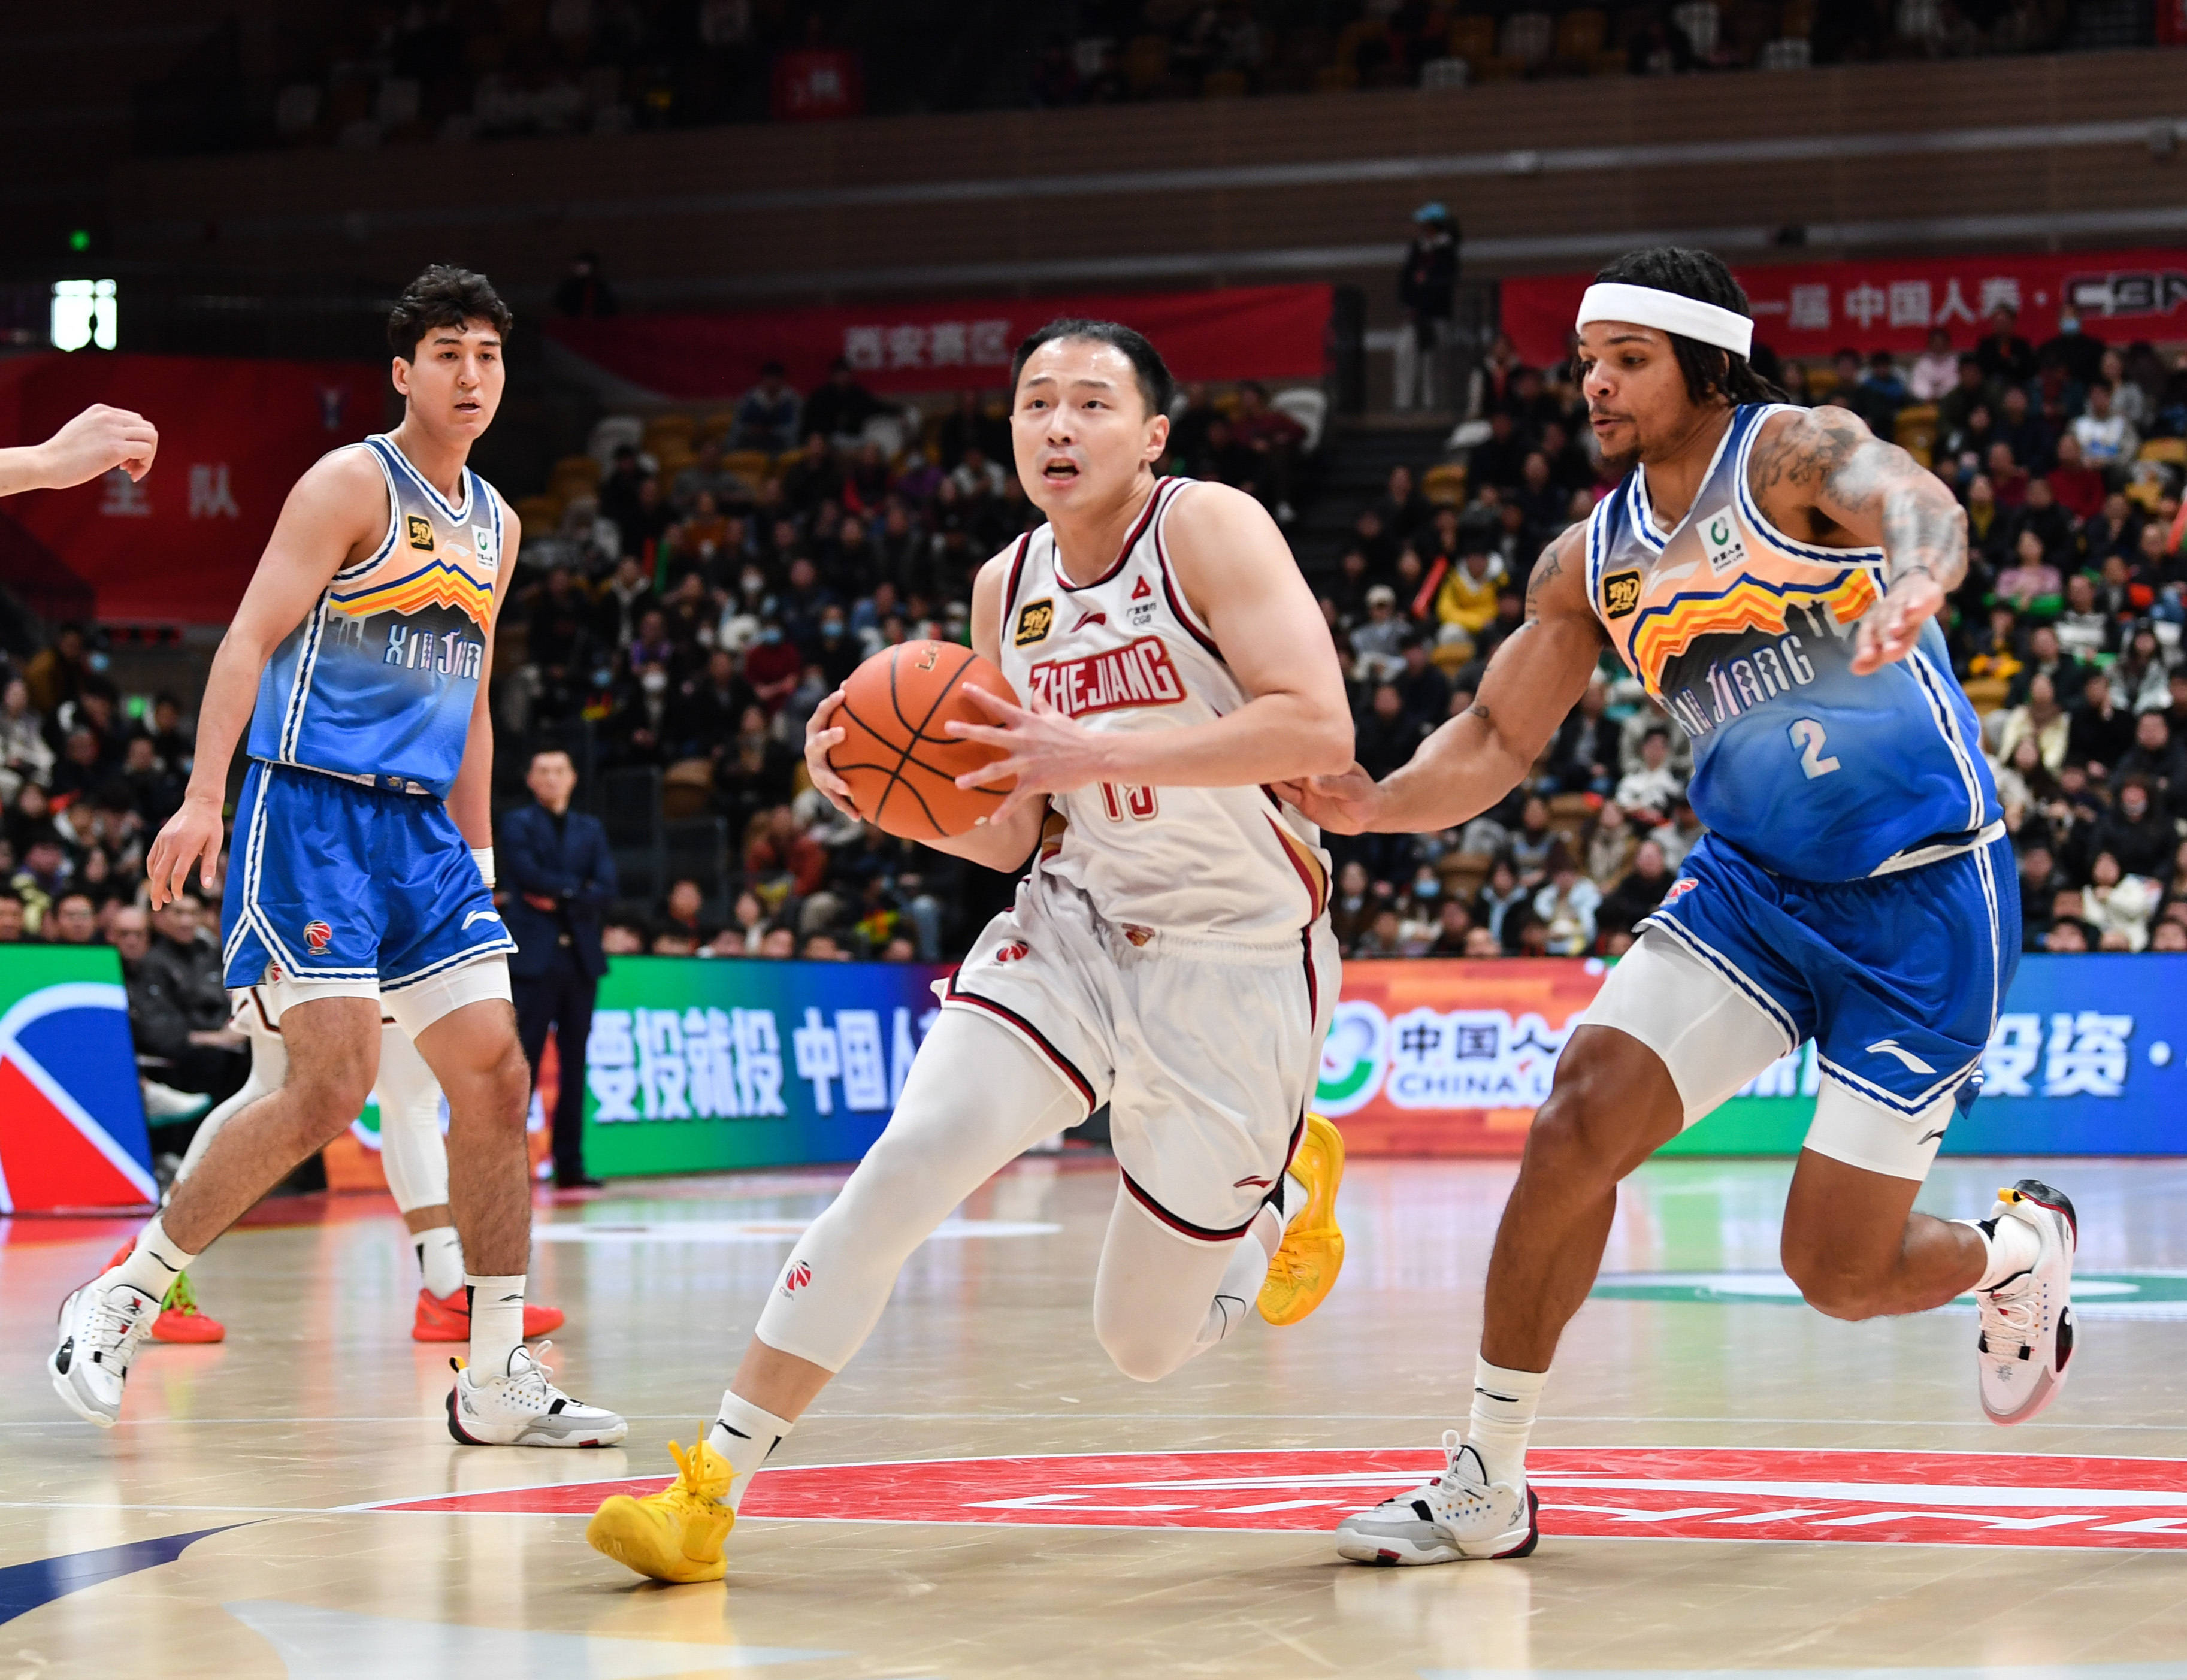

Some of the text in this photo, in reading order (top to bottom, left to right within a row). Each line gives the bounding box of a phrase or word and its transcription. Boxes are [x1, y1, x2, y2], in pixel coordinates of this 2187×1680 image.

[1030, 640, 1182, 716] ZHEJIANG
[1787, 717, 1841, 780] 2
[1400, 1022, 1557, 1062] 中国人
[1397, 1070, 1517, 1097] CHINA
